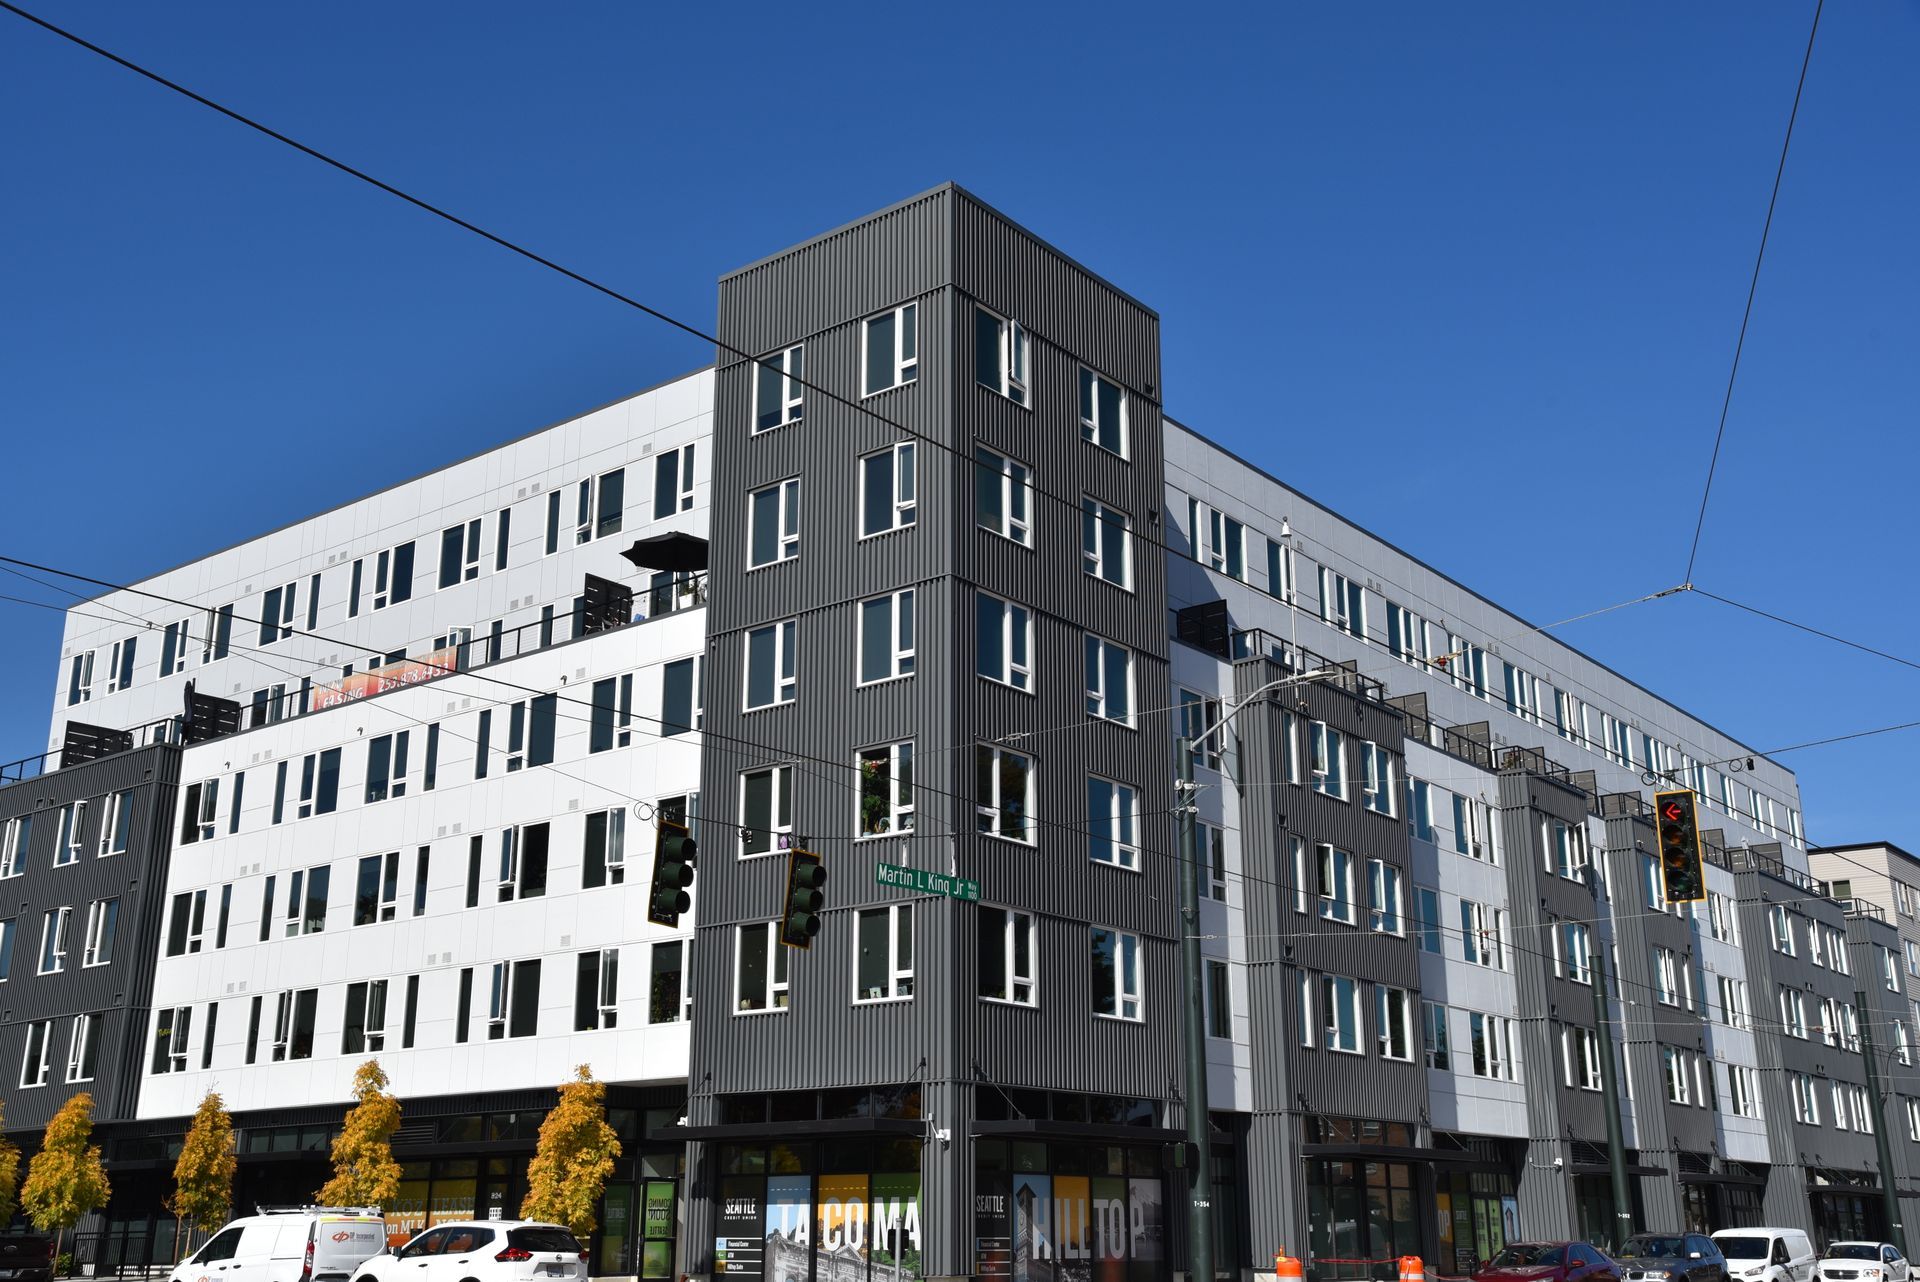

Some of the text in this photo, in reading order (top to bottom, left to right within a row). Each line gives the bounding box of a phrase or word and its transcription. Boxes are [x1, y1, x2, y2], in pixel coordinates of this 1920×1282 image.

[878, 864, 964, 896] Martin L King Jr
[967, 882, 978, 891] Way
[391, 1198, 423, 1217] KOZ
[433, 1197, 475, 1215] LEASE
[725, 1198, 756, 1215] SEATTLE
[976, 1195, 1004, 1213] SEATTLE
[386, 1223, 398, 1234] on
[776, 1196, 921, 1251] TACOMA
[1032, 1198, 1145, 1260] HILLTOP
